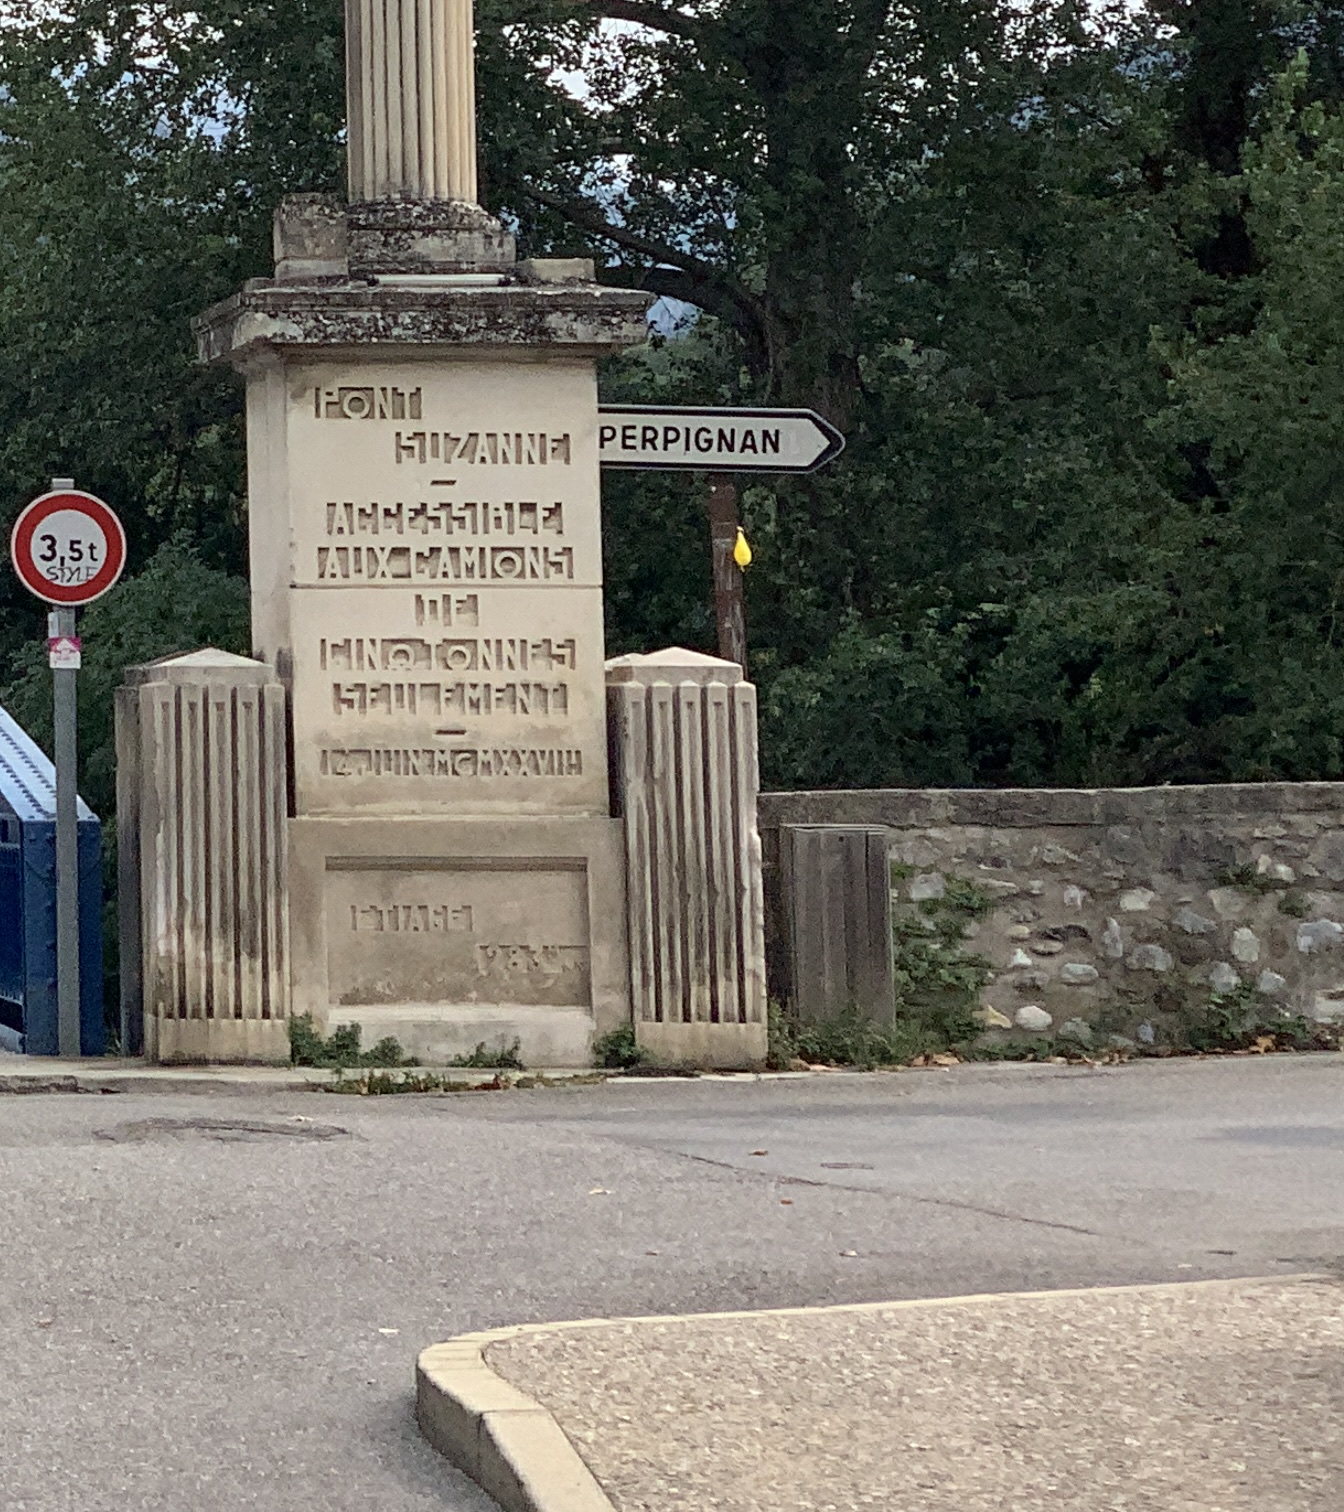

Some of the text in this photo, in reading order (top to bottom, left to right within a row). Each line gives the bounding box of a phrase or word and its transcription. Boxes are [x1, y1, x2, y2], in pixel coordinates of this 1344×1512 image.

[315, 388, 422, 419] PONT
[396, 433, 571, 464] SUZANNE
[599, 425, 780, 454] PERPIGNAN
[327, 502, 563, 535] ACCESSIBLE
[46, 566, 98, 583] STYLE
[318, 547, 574, 579] AUX CAMIONS
[415, 593, 479, 626] DE
[320, 638, 576, 670] CINQ TONNES
[333, 683, 568, 715] SEULEMENT
